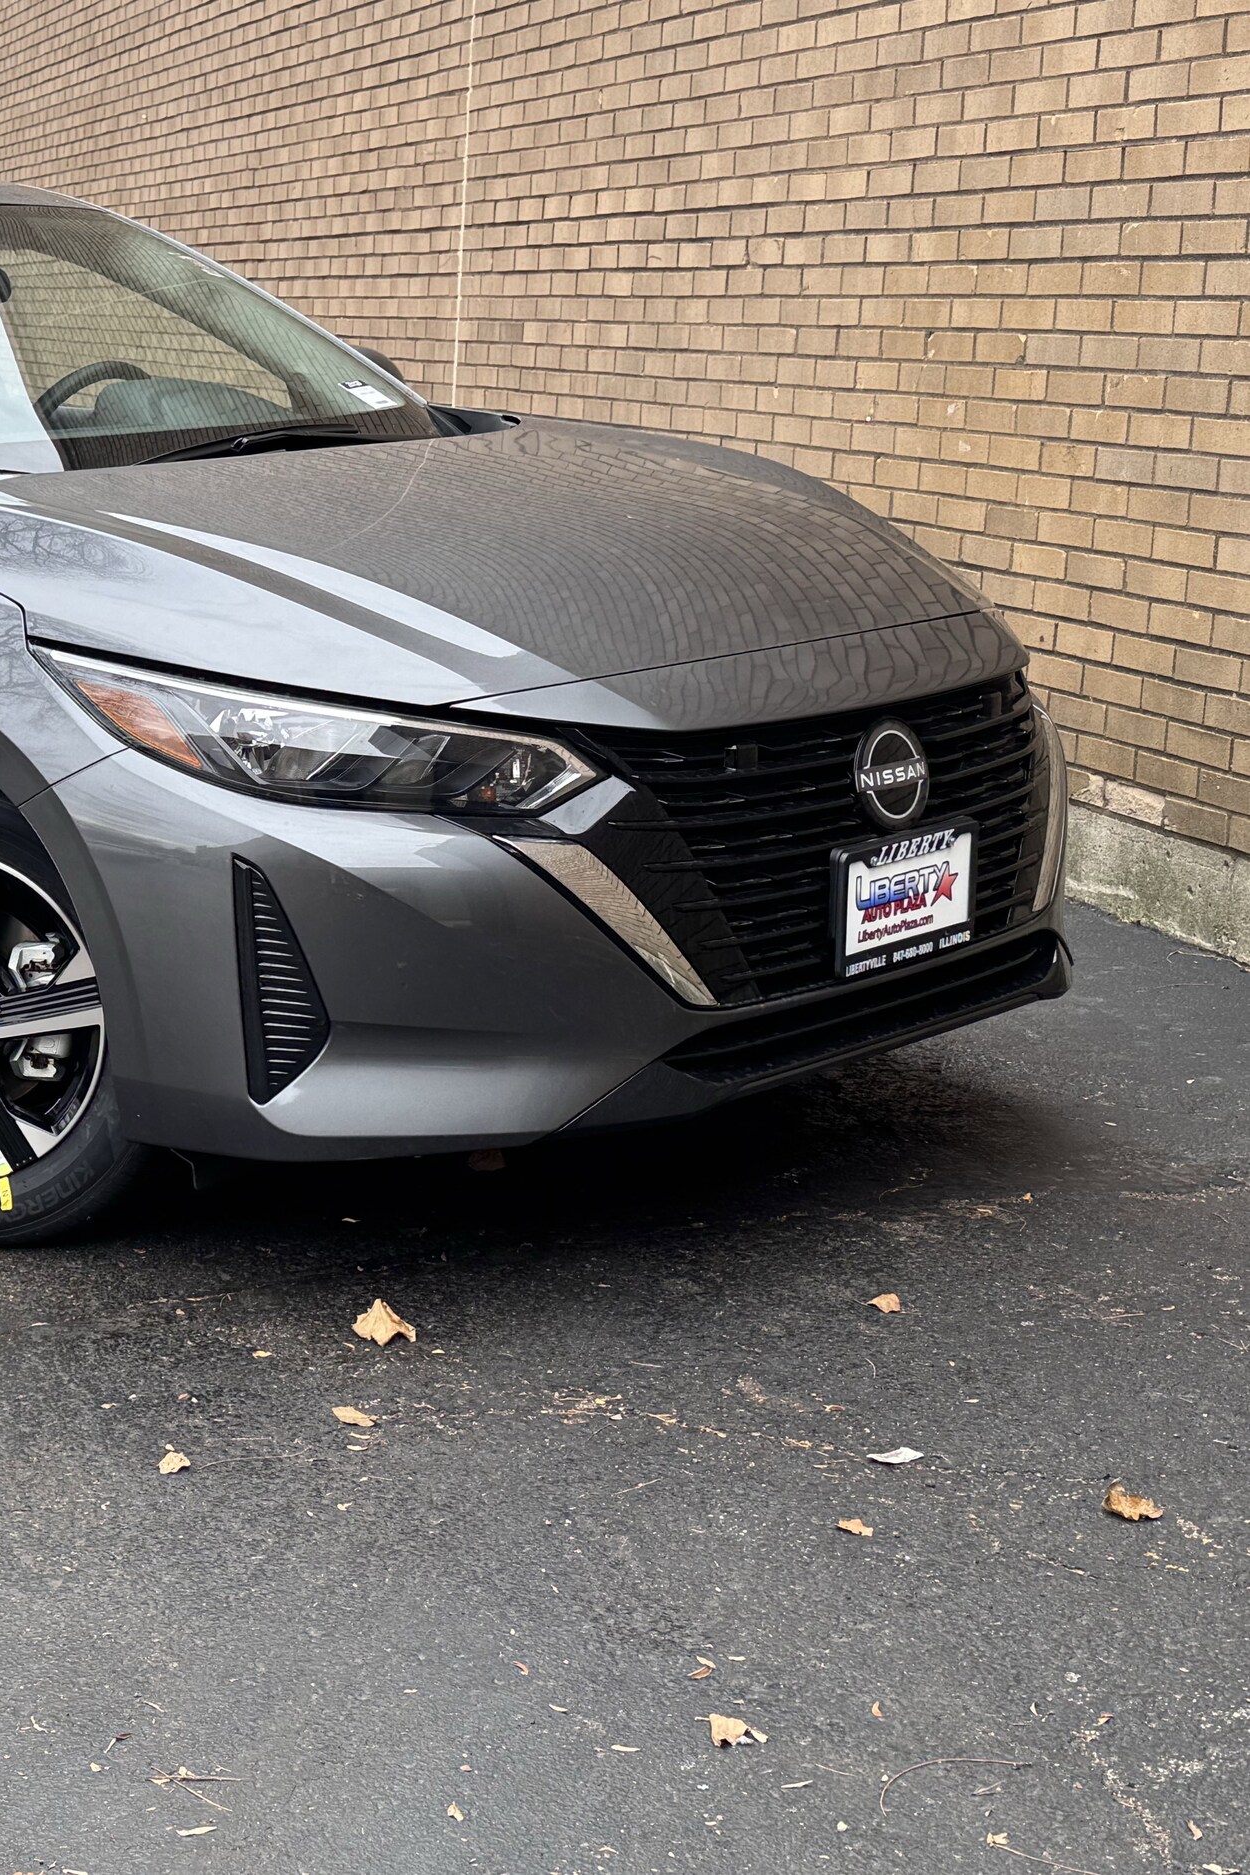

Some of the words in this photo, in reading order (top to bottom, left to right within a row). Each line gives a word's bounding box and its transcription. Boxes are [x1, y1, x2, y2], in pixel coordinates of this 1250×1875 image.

[860, 761, 925, 788] NISSAN
[877, 829, 955, 866] LIBERTY
[856, 861, 950, 911] LIBERTY
[861, 902, 892, 925] AUTO
[894, 893, 927, 915] PLAZA
[858, 914, 934, 943] LibertyAutoPlaza.com
[845, 955, 887, 977] LIBERTYVILLE
[939, 930, 971, 949] ILLINOIS
